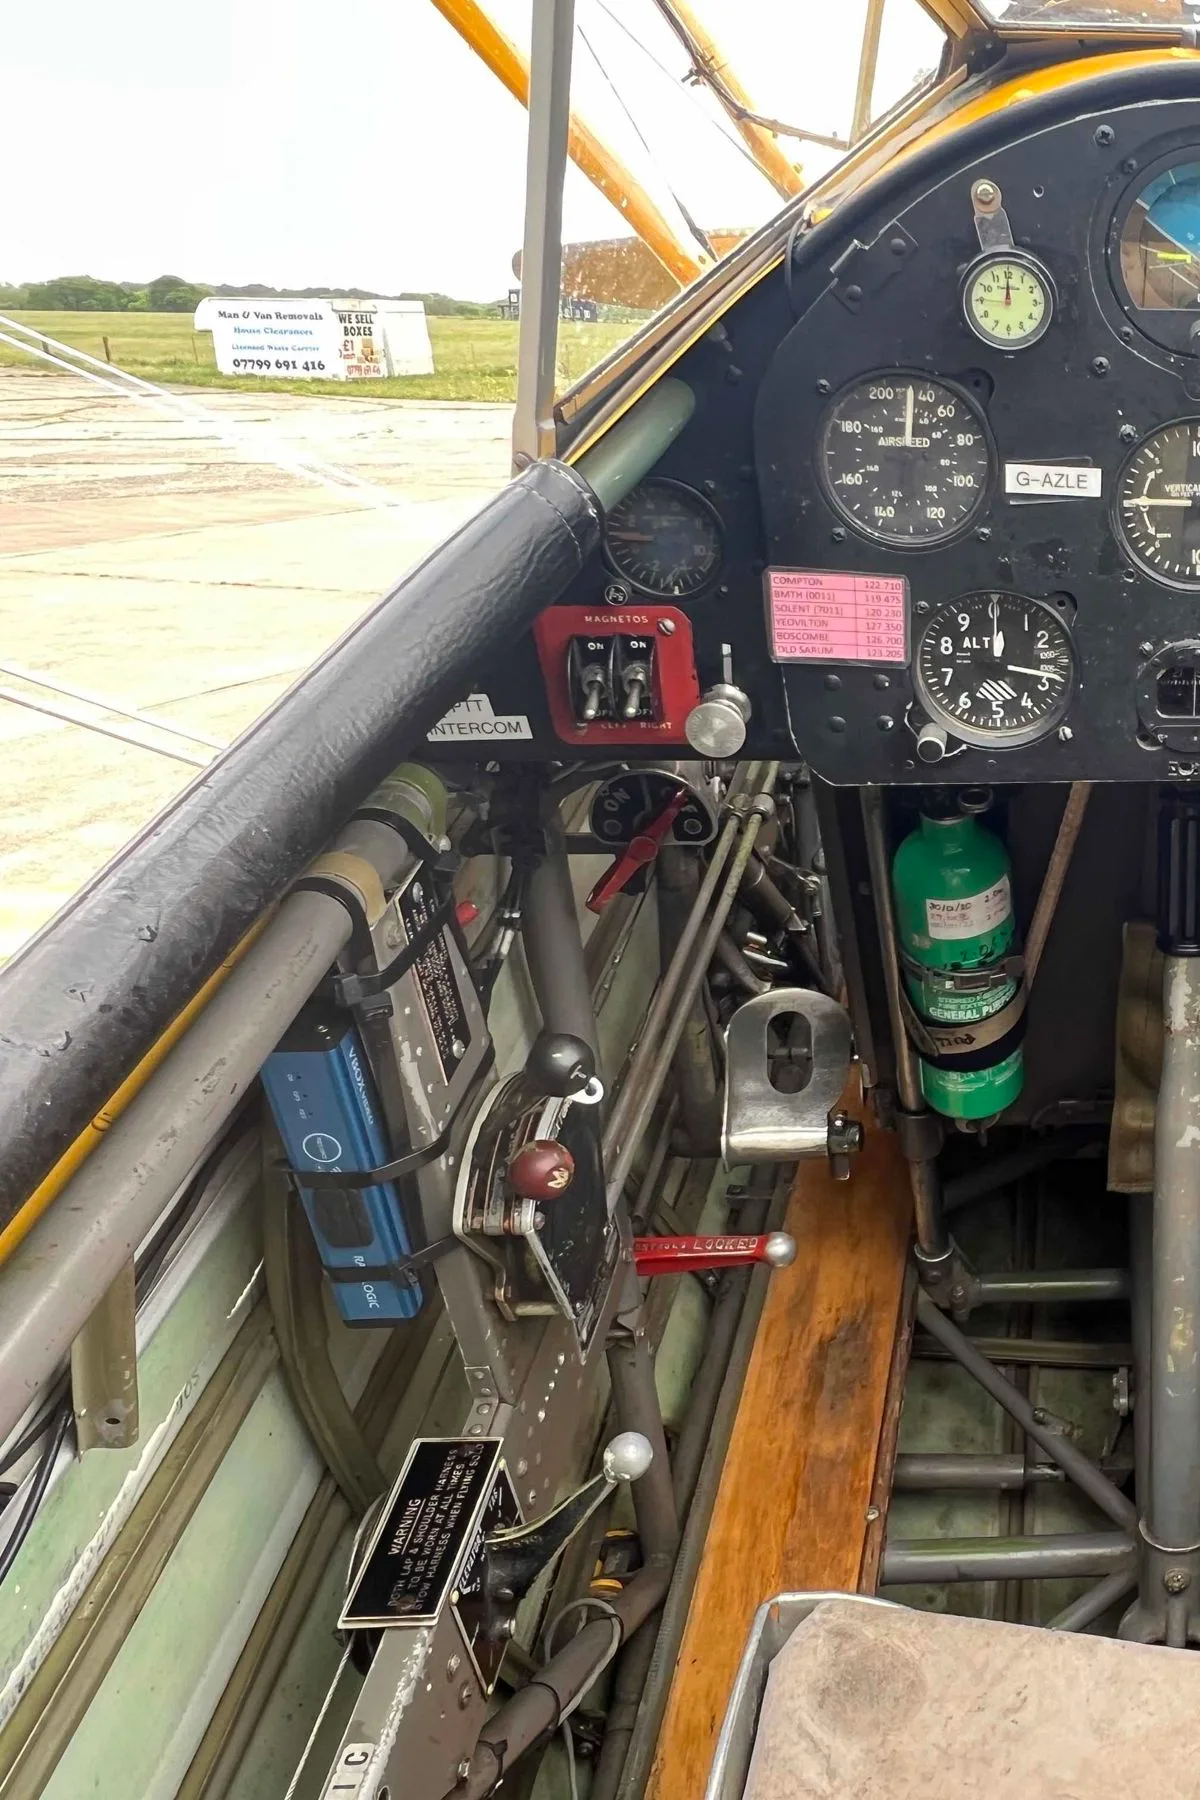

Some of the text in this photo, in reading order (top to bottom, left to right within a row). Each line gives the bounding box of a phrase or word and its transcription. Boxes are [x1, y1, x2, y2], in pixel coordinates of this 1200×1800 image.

[218, 311, 239, 319] Man
[253, 311, 272, 320] Van
[275, 312, 323, 321] Removals
[338, 314, 374, 325] WE SELL
[343, 326, 373, 337] BOXES
[233, 358, 271, 370] 07799
[275, 359, 297, 370] 691
[869, 387, 893, 400] 200
[918, 390, 935, 402] 40
[937, 405, 955, 417] 60
[841, 421, 861, 434] 180
[878, 437, 930, 447] AIRSEED
[957, 434, 973, 446] 80
[842, 473, 862, 486] 160
[953, 475, 974, 487] 100
[1016, 471, 1088, 489] G-AZLE
[875, 506, 895, 518] 140
[927, 507, 945, 518] 120
[773, 576, 901, 590] COMPTON 122.710
[774, 590, 803, 599] BMTH
[774, 604, 810, 613] SOLENT
[585, 615, 648, 623] MAGNETOS
[776, 618, 902, 632] YEOVILTON 127.350
[957, 613, 970, 631] 9
[1024, 613, 1028, 631] 1
[940, 637, 953, 654] 8
[962, 637, 990, 648] ALT
[1036, 630, 1049, 648] 2
[799, 646, 833, 655] SARUM
[867, 648, 902, 658] 123.205
[941, 668, 953, 686] 7
[959, 692, 971, 709] 6
[1021, 692, 1033, 708] 4
[991, 702, 1004, 718] 5
[603, 788, 631, 812] ON
[929, 1006, 980, 1019] GENERAL
[401, 1558, 414, 1576] LAP
[414, 1494, 440, 1544] SHOULDER
[435, 1449, 457, 1491] HARNESS
[415, 1560, 427, 1572] BE
[422, 1528, 440, 1559] WORN
[435, 1513, 445, 1524] AT
[440, 1495, 454, 1512] ALL
[447, 1463, 465, 1494] TIMES
[388, 1499, 421, 1556] WARNING
[427, 1532, 450, 1579] HARNESS
[446, 1502, 462, 1530] WHEN
[457, 1468, 476, 1503] FLYING
